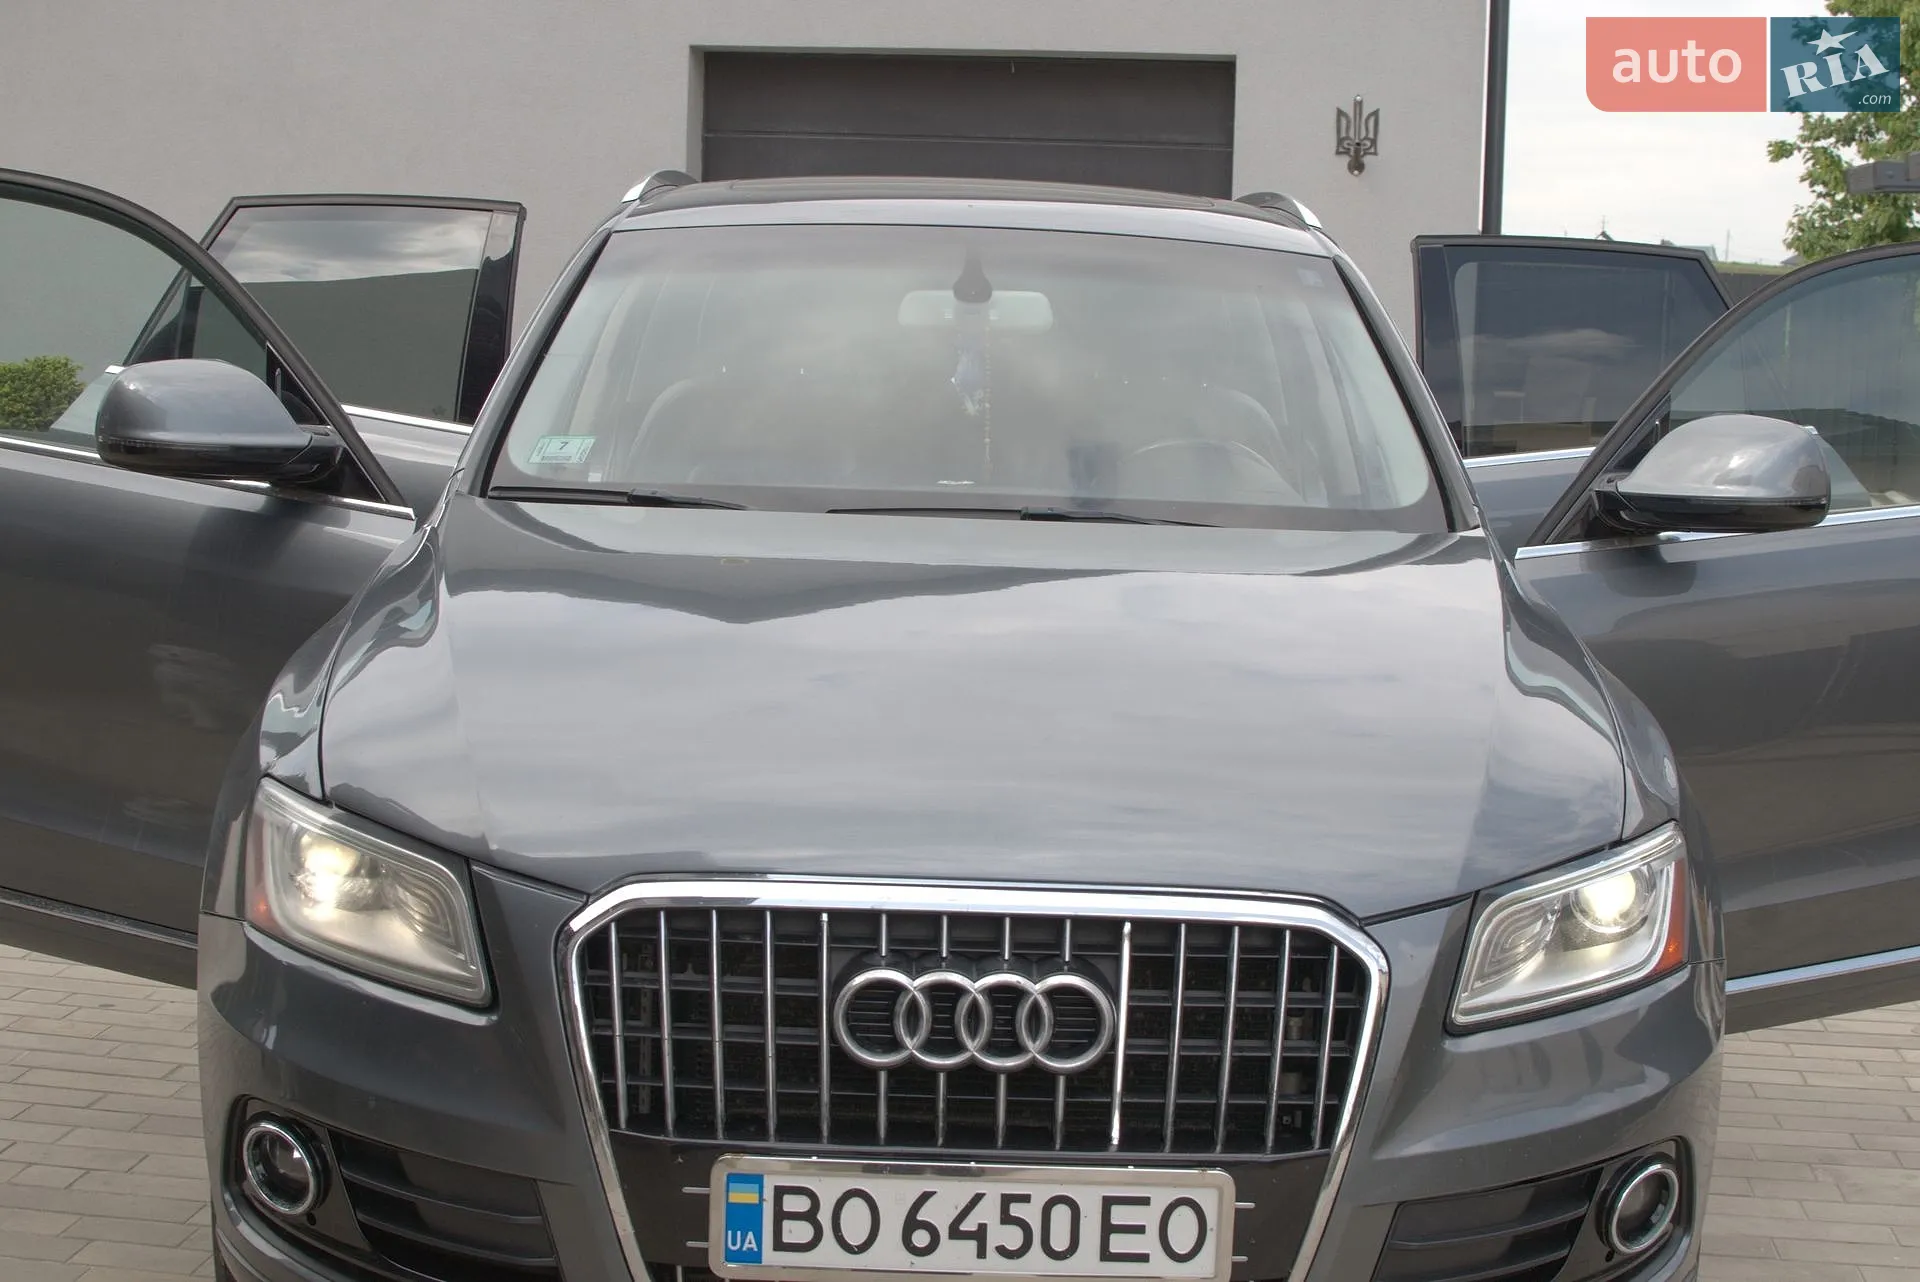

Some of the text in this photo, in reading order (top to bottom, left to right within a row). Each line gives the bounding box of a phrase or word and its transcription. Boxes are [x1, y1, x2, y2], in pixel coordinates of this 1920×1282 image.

[727, 1230, 758, 1252] UA
[773, 1184, 1208, 1263] BO 6450 EO
